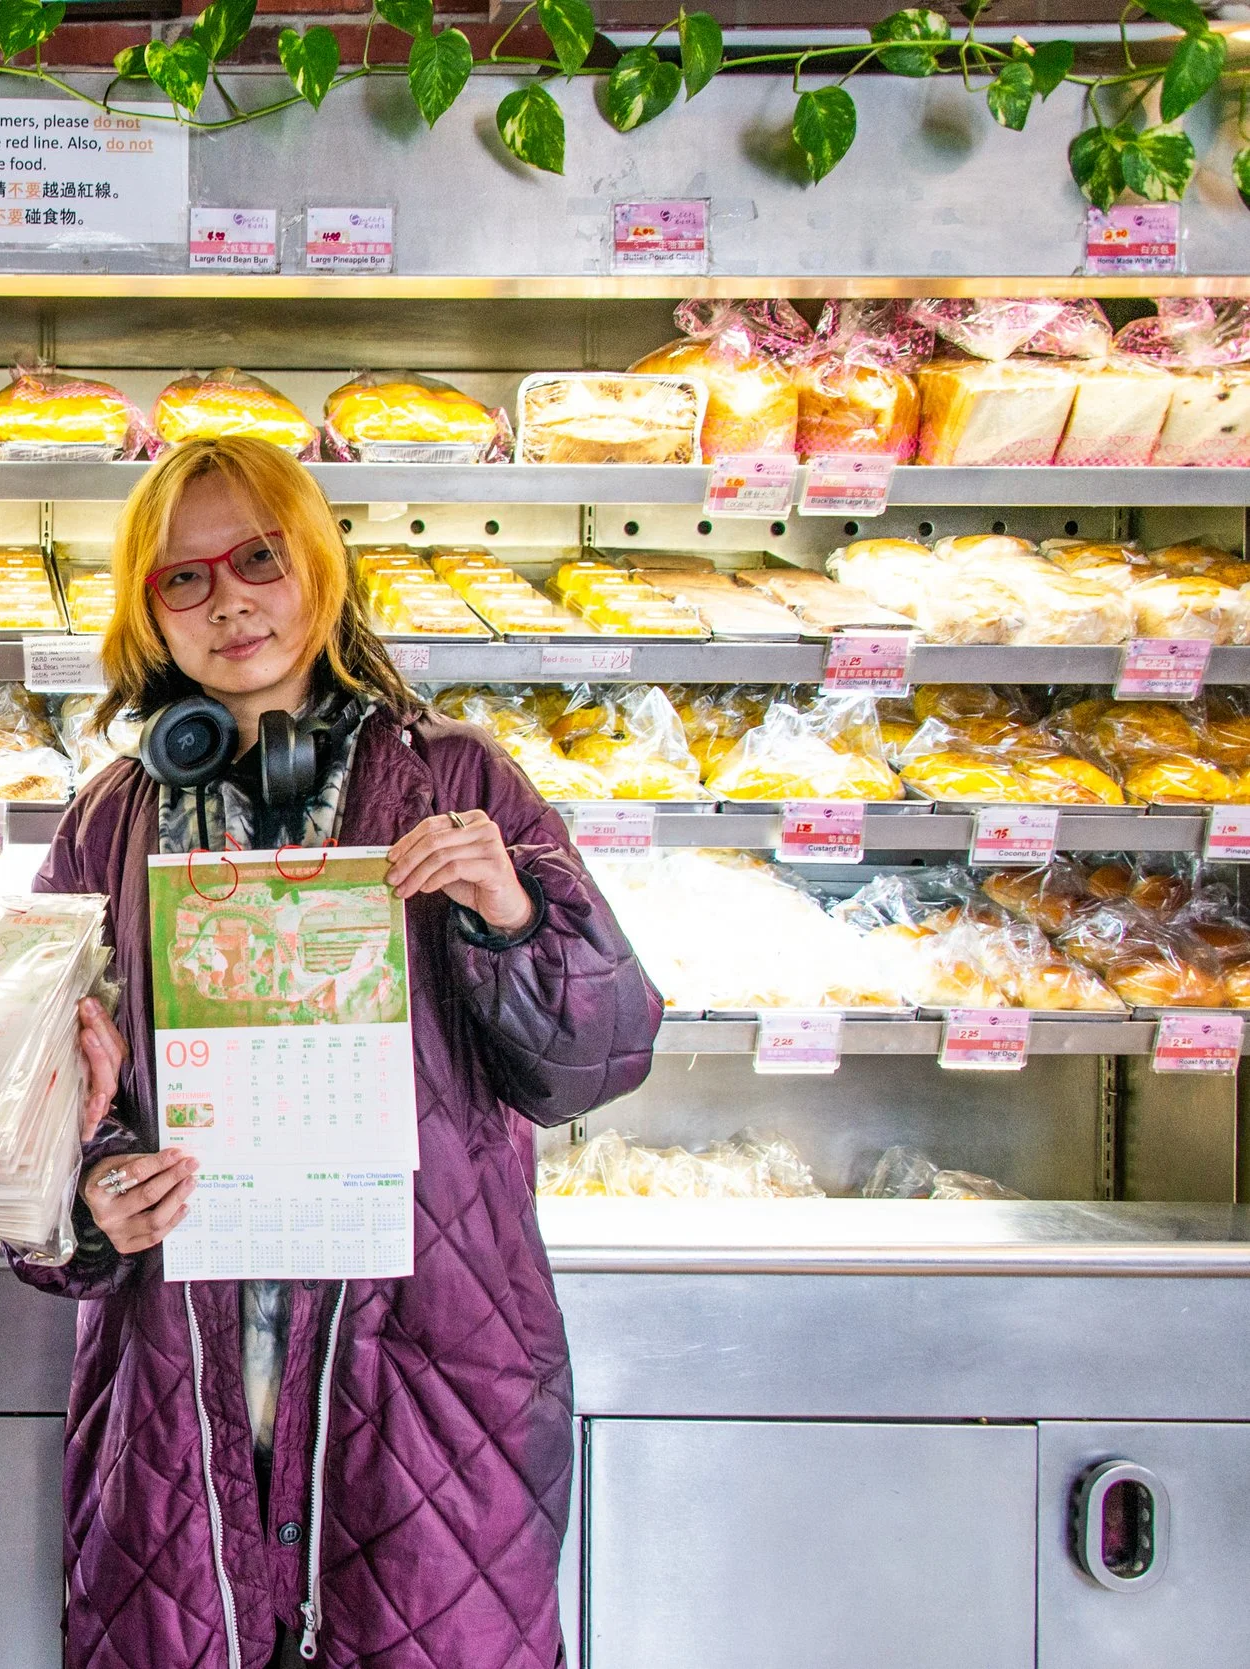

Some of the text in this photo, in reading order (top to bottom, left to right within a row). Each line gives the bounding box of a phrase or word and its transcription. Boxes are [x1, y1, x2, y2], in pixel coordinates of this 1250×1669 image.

[42, 114, 86, 131] please
[91, 115, 110, 131] do
[114, 116, 137, 131] not
[5, 136, 27, 149] red
[32, 136, 61, 150] line.
[66, 136, 99, 152] Also,
[103, 137, 121, 152] do
[126, 138, 150, 152] not
[10, 157, 46, 171] food.
[194, 255, 215, 263] Large
[311, 256, 331, 264] Large
[333, 256, 369, 266] Pineapple
[649, 253, 674, 261] Pound
[676, 253, 695, 261] Cake
[542, 650, 630, 669] Red Beans 豆沙
[871, 679, 891, 687] Bread
[166, 1040, 210, 1068] 09
[1002, 1051, 1017, 1059] Dog
[1178, 1058, 1198, 1066] Roast
[1216, 1059, 1229, 1067] Bun
[167, 1083, 183, 1091] 九月
[366, 1172, 405, 1180] Chinatown,
[342, 1180, 358, 1188] With
